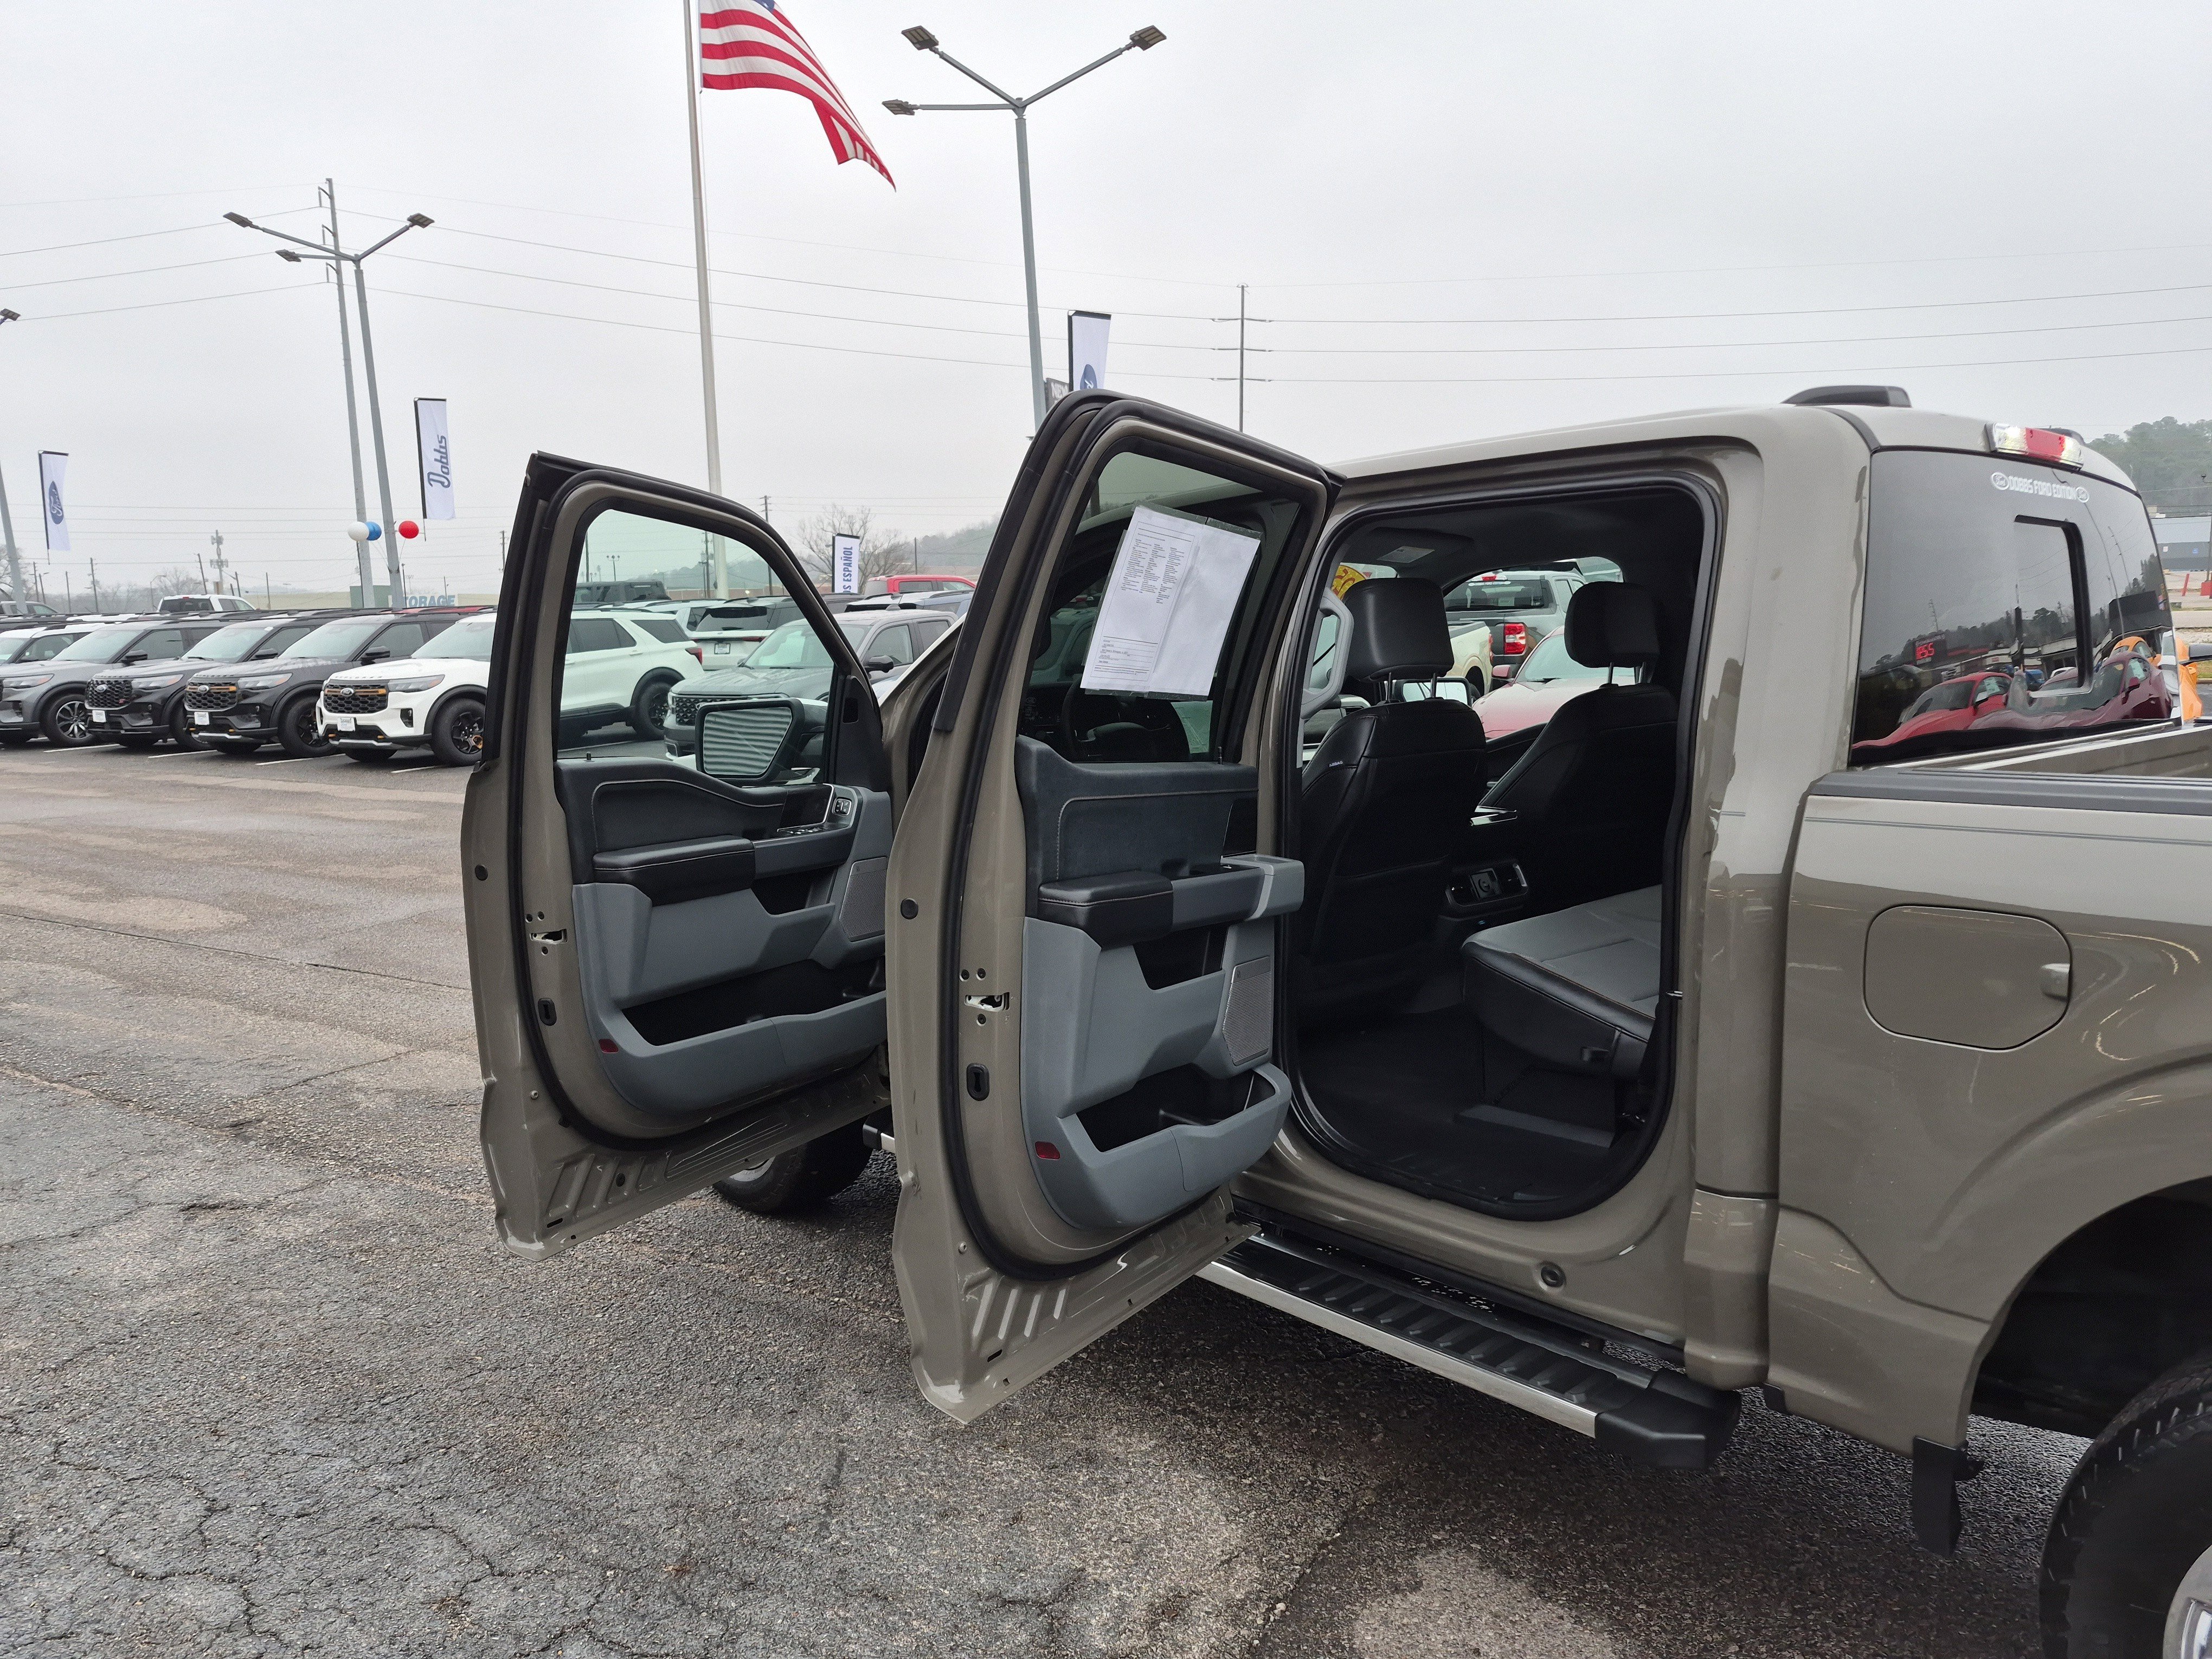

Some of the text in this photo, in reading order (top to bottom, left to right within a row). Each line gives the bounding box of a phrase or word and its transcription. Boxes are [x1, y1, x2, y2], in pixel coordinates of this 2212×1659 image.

[427, 434, 451, 488] Dobbs
[2008, 475, 2034, 493] DOBBS
[2034, 480, 2052, 497] FORD
[2052, 484, 2076, 500] EDITION
[840, 546, 853, 582] ESPAÑOL
[400, 595, 455, 607] TORAGE
